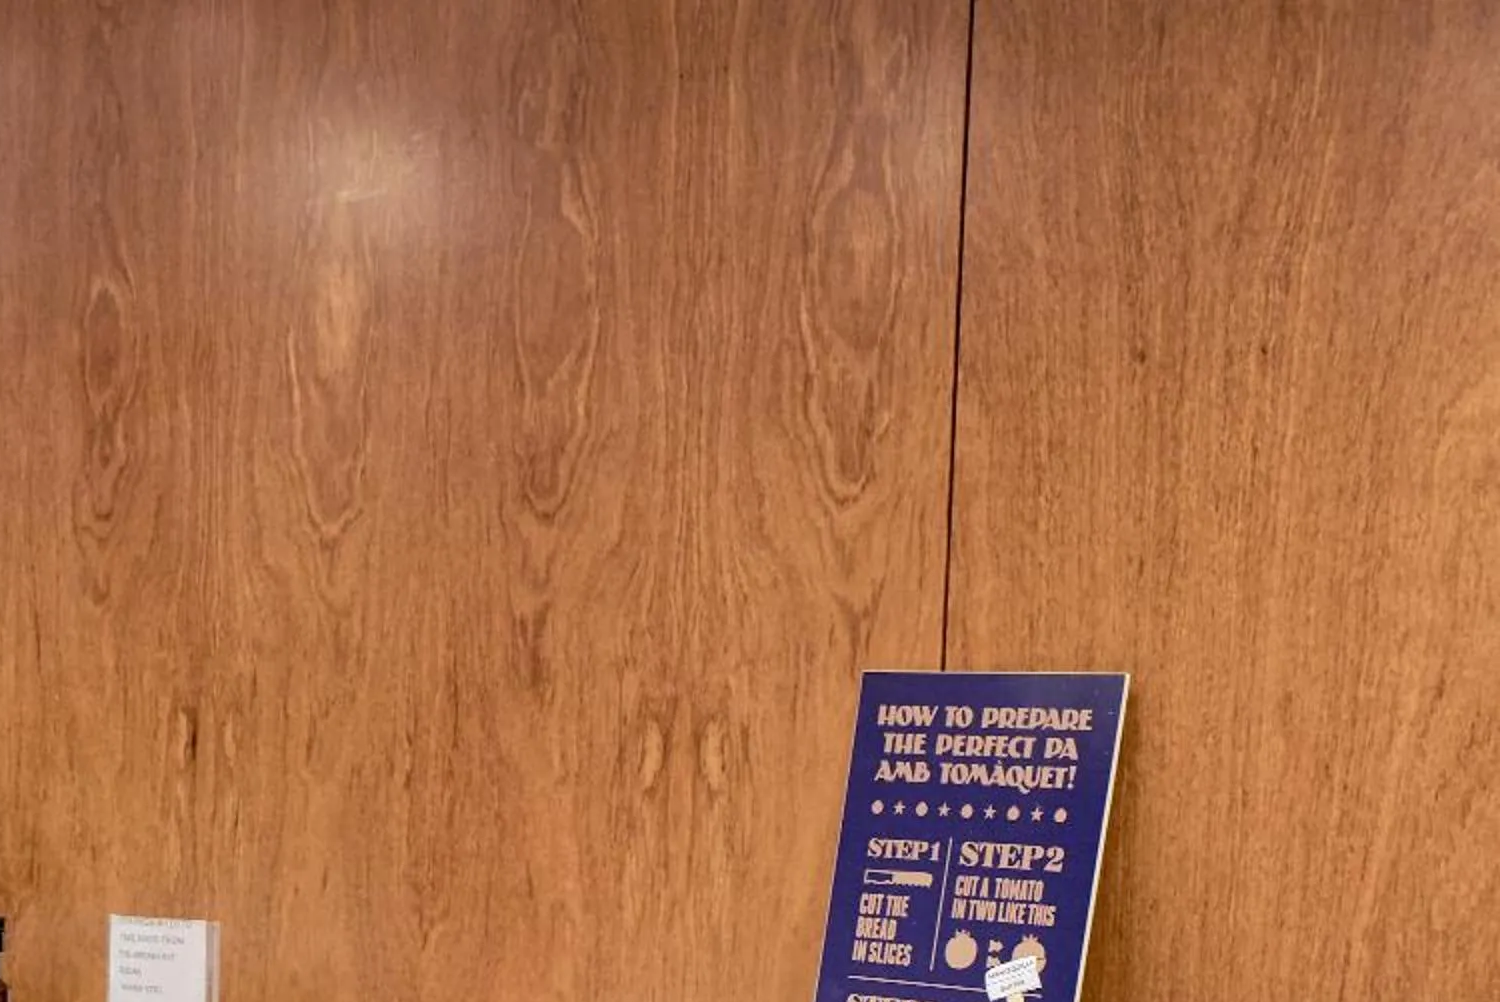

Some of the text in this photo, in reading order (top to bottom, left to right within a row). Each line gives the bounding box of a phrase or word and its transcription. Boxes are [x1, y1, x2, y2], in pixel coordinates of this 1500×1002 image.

[877, 704, 1093, 731] HOW TO PREPARE
[883, 732, 1078, 760] THE PERFECT PA
[874, 759, 931, 783] AMB
[954, 875, 1045, 902] CUT A TOMATO
[859, 893, 911, 918] CUT THE
[952, 898, 1057, 927] IN TWO LIKE THIS
[855, 916, 898, 941] BREAD
[852, 939, 913, 967] IN SLICES
